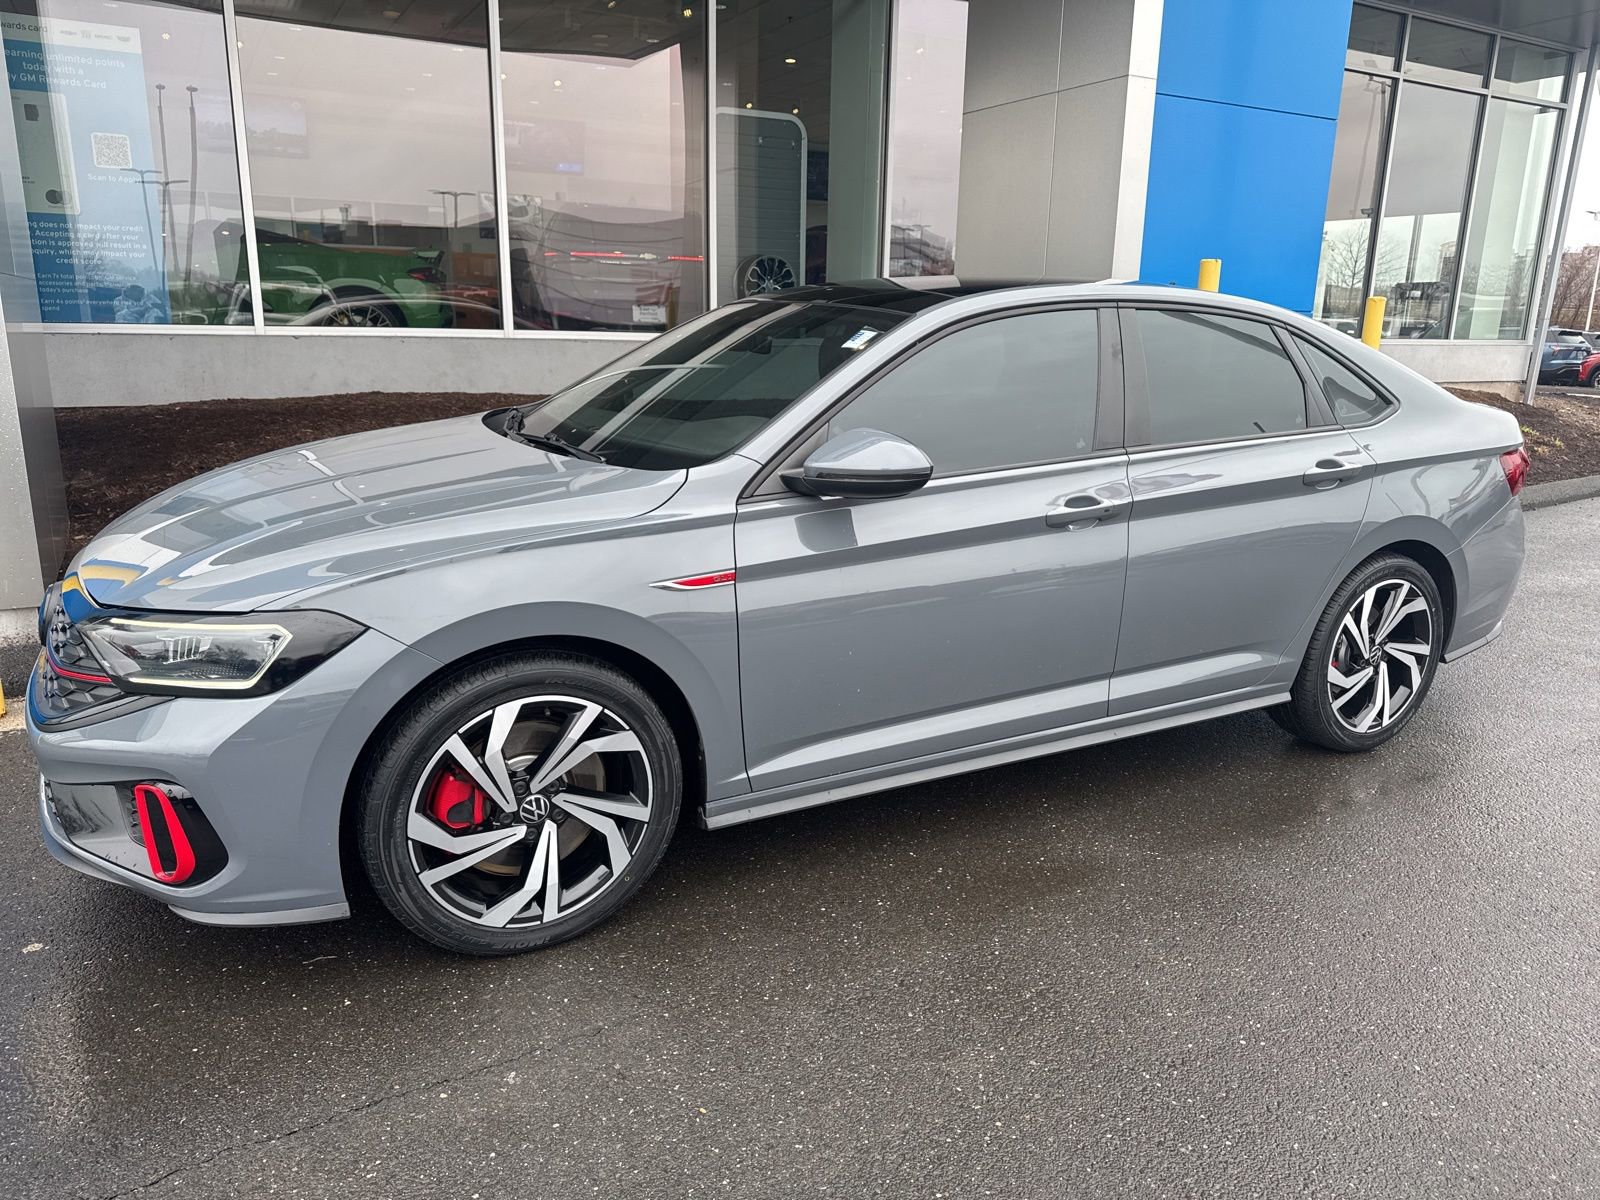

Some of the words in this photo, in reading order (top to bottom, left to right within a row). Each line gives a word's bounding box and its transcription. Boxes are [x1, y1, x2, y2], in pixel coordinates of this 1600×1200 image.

[46, 52, 93, 65] unlimited
[95, 57, 126, 69] points
[22, 60, 50, 73] today
[54, 64, 76, 75] with
[78, 68, 84, 76] a
[19, 72, 36, 83] GM
[83, 78, 107, 90] Card
[87, 173, 107, 183] Scan
[108, 175, 117, 183] to
[39, 221, 58, 229] does
[102, 224, 120, 232] your
[34, 230, 74, 239] Accepting
[122, 234, 139, 242] your
[109, 241, 132, 249] result
[133, 242, 141, 250] in
[100, 250, 127, 259] impact
[128, 252, 146, 260] your
[520, 795, 549, 823] VW
